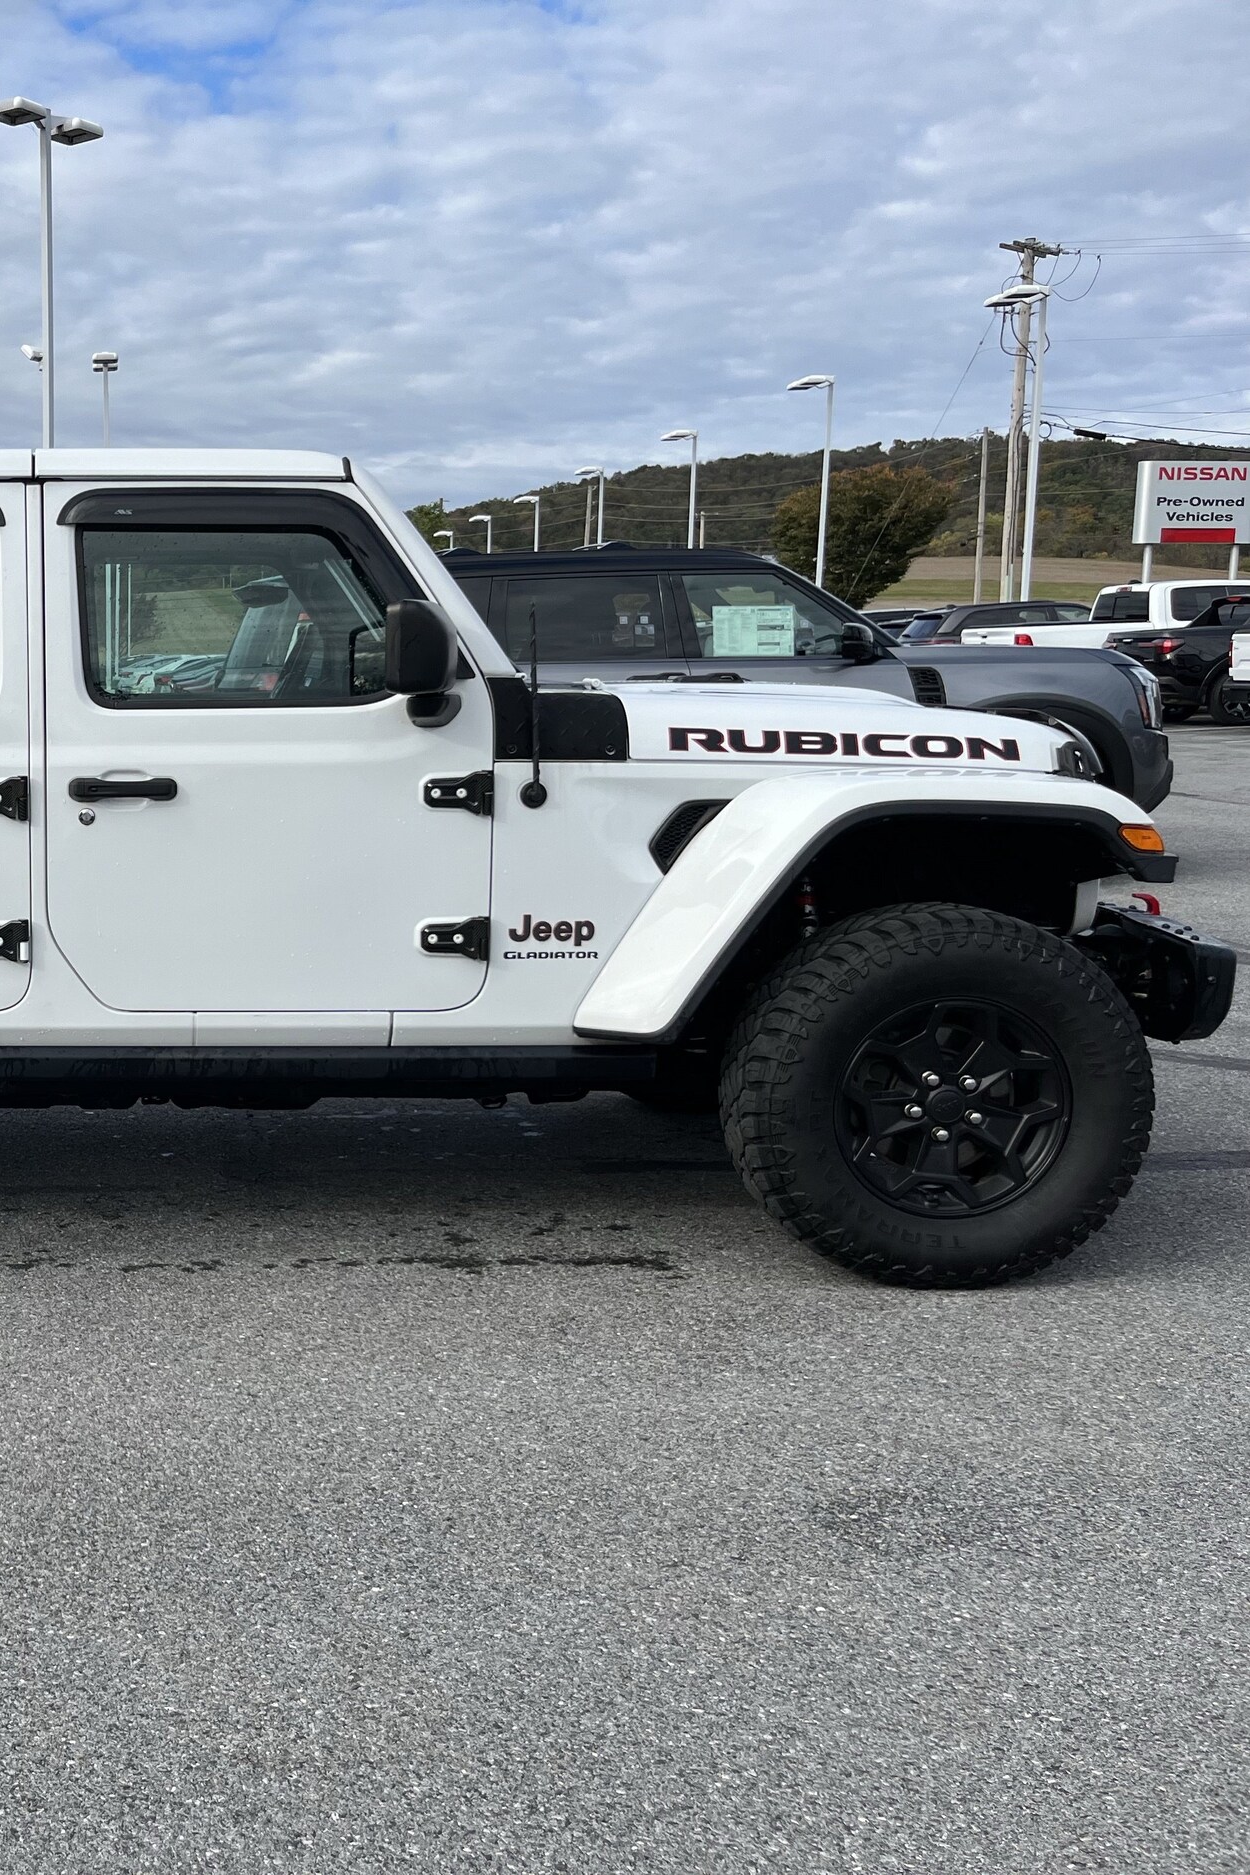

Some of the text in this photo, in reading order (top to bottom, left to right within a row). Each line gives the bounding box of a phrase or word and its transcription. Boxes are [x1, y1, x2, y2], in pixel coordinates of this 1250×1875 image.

[1158, 467, 1248, 481] NISSAN
[1156, 496, 1245, 507] Pre-Owned
[1166, 512, 1234, 522] Vehicles
[668, 727, 1021, 761] RUBICON
[508, 914, 595, 947] Jeep
[503, 951, 599, 960] GLADIATOR
